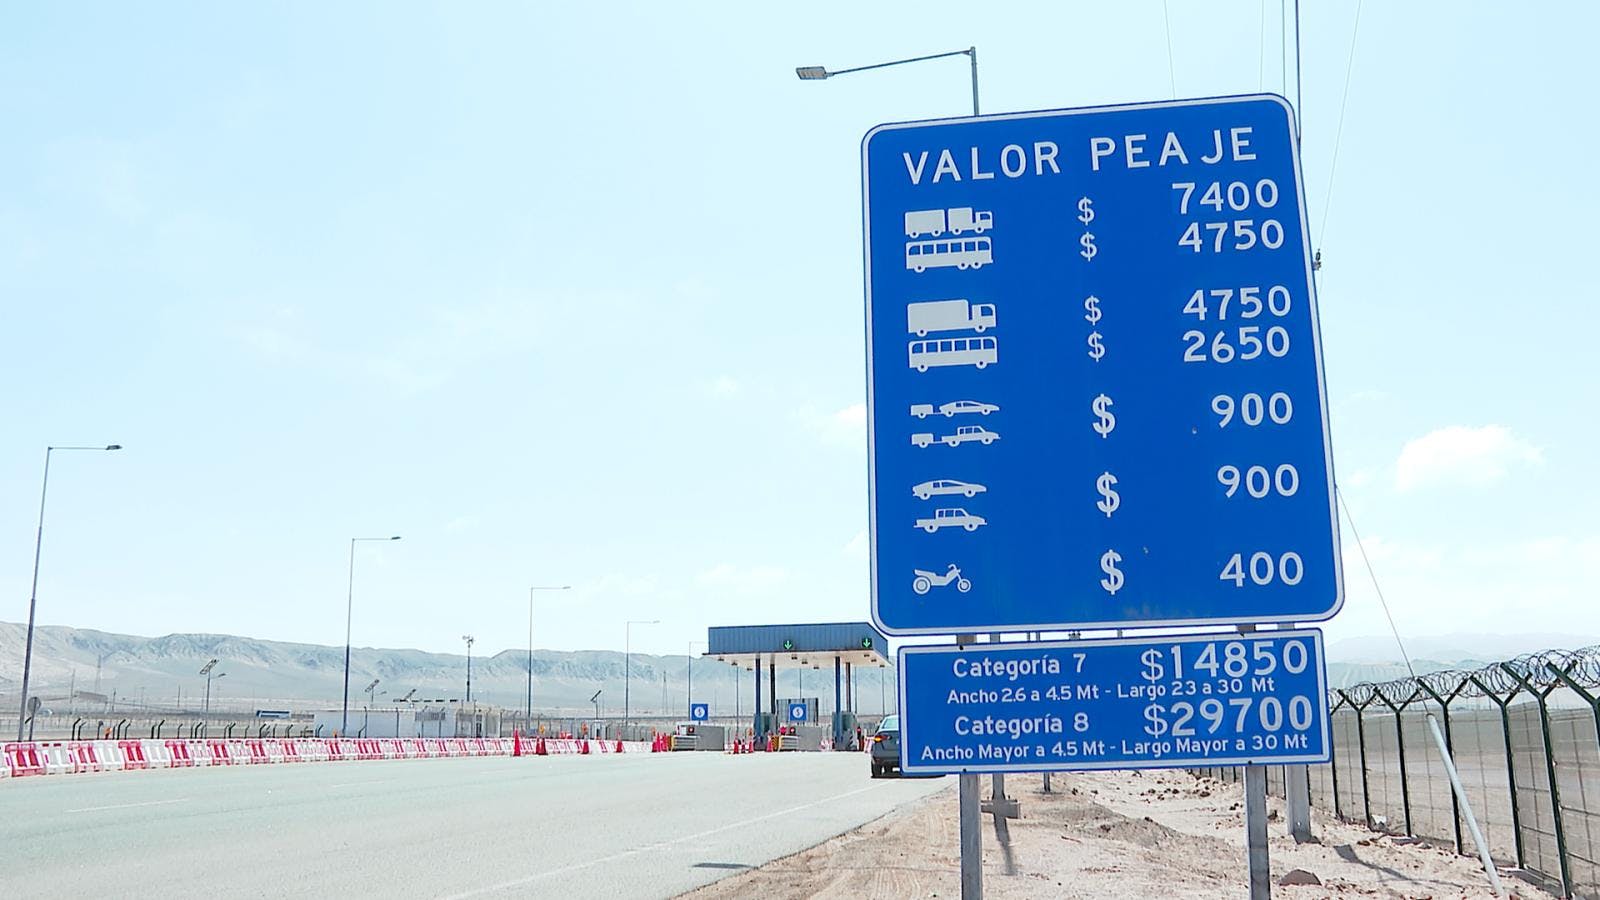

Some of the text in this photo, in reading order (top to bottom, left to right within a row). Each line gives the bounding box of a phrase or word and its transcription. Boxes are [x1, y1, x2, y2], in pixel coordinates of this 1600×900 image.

[903, 127, 1258, 185] VALOR PEAJE
[1077, 178, 1279, 226] $ 7400
[1080, 219, 1284, 262] $ 4750
[1084, 285, 1291, 326] $ 4750
[1087, 326, 1290, 363] $ 2650
[1092, 392, 1293, 439] $ 900
[1096, 463, 1299, 518] $ 900
[1100, 549, 1304, 595] $ 400
[953, 639, 1308, 684] Categoría 7 $14850
[947, 689, 998, 704] Ancho
[1001, 687, 1027, 702] 2.6
[1030, 690, 1040, 701] a
[1045, 685, 1072, 701] 4.5
[1077, 685, 1099, 700] Mt
[1117, 683, 1166, 701] Largo
[1171, 680, 1197, 696] 23
[1202, 682, 1212, 695] a
[1217, 678, 1243, 694] 30
[1251, 677, 1275, 693] Mt
[954, 695, 1313, 740] Categoría 8 $29700
[921, 745, 974, 760] Ancho
[978, 744, 1030, 762] Mayor
[1035, 745, 1045, 757] a
[1051, 741, 1078, 757] 4.5
[1083, 741, 1105, 756] Mt
[1122, 740, 1171, 758] Largo
[1176, 737, 1229, 756] Mayor
[1235, 739, 1246, 751] a
[1252, 734, 1278, 750] 30
[1284, 733, 1308, 749] Mt
